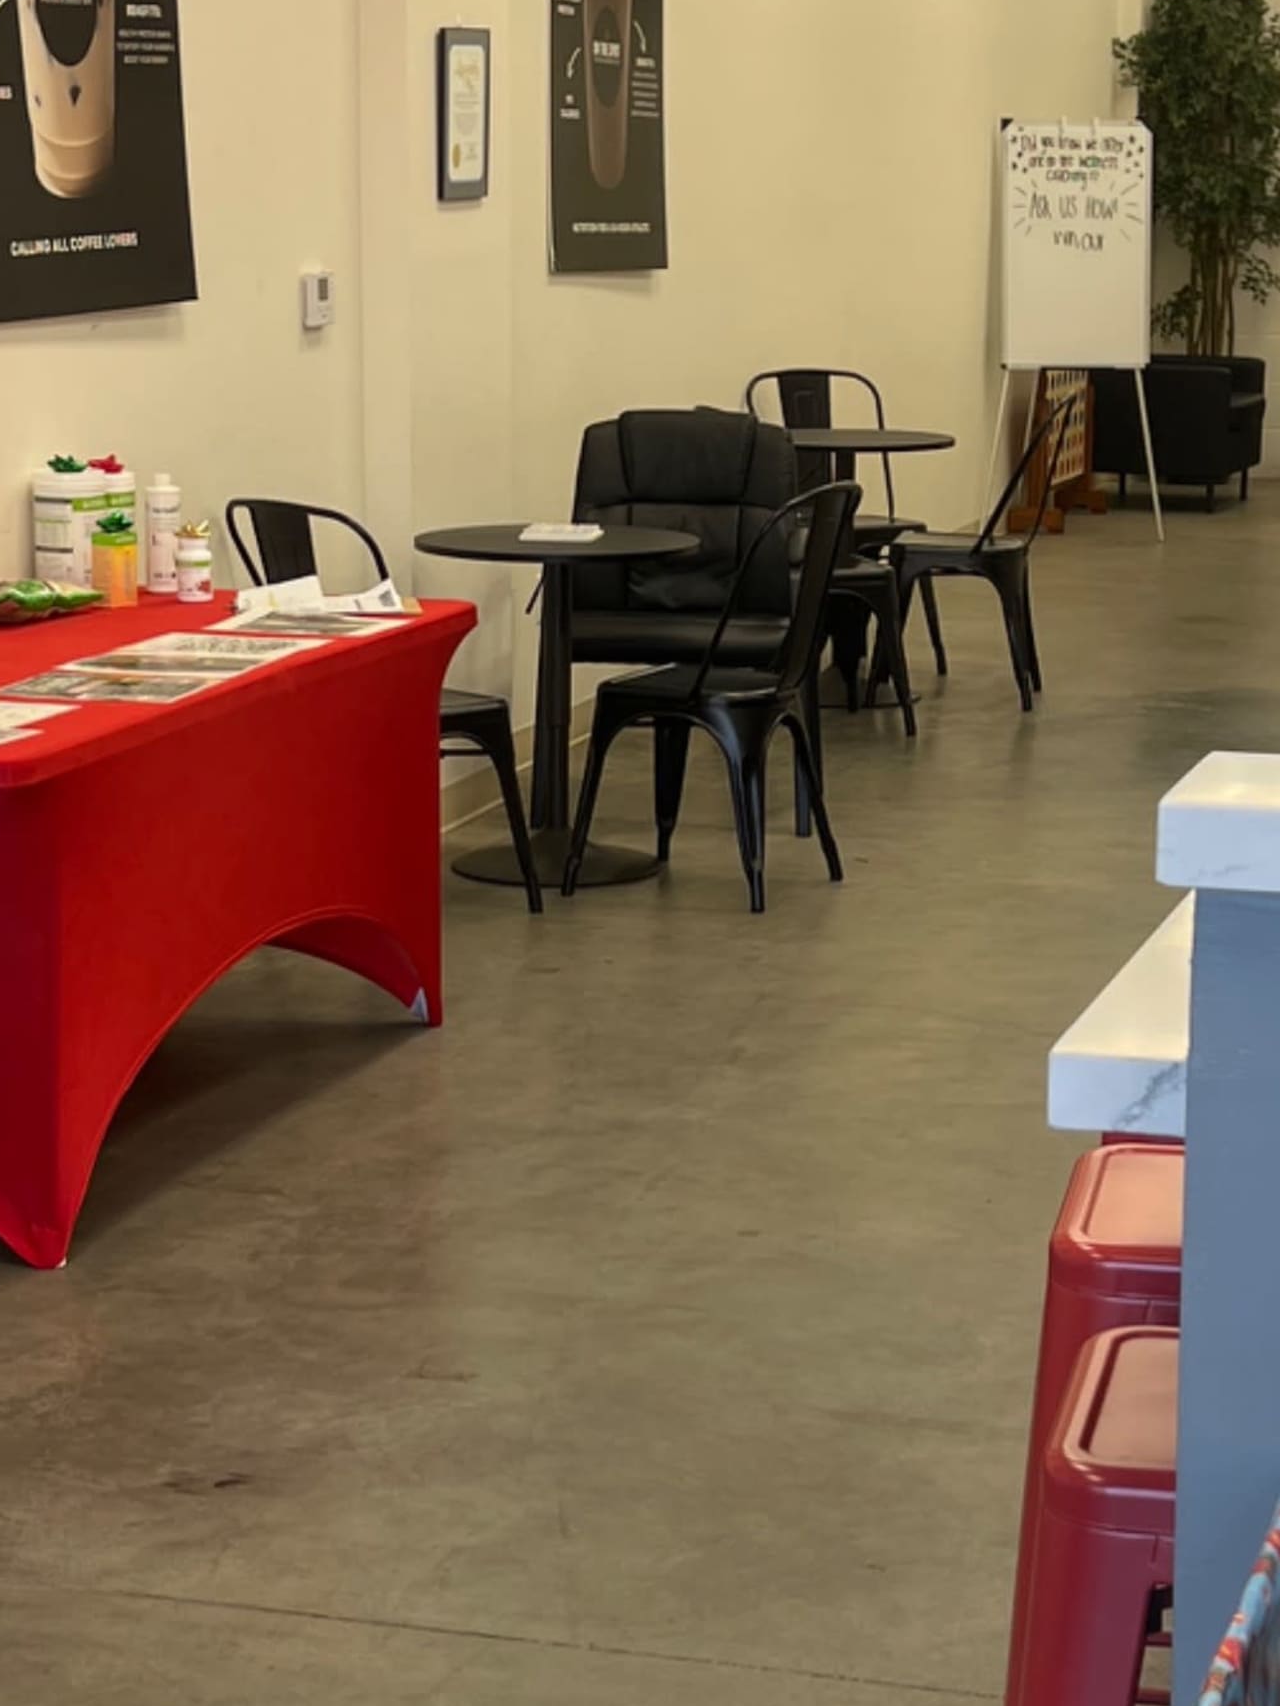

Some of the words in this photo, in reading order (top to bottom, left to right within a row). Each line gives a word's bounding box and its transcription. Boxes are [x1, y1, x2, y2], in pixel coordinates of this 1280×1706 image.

[10, 239, 51, 257] CALLING
[53, 237, 69, 252] ALL
[70, 234, 103, 250] COFFEE
[104, 231, 138, 248] LOVERS
